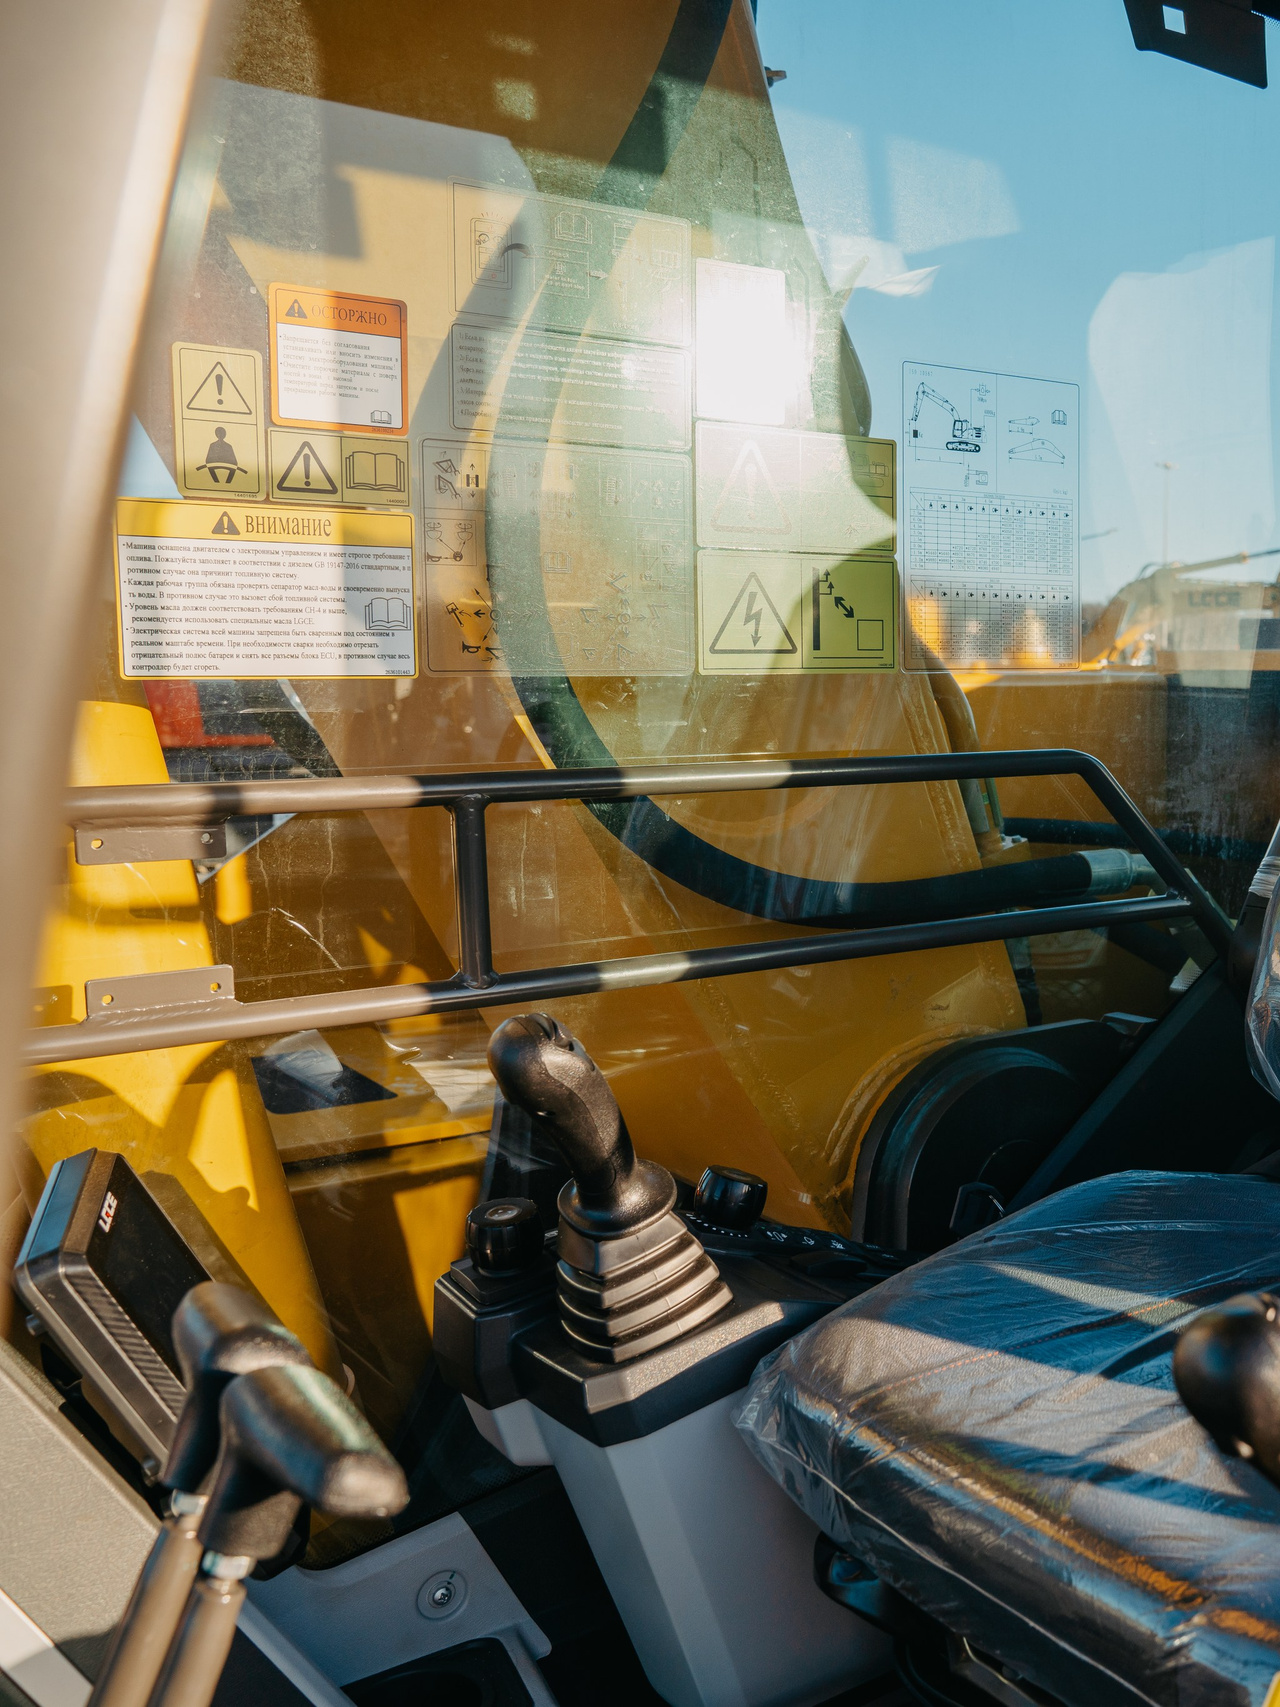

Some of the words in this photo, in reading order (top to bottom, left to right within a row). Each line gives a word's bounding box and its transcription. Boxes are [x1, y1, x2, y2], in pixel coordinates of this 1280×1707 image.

[312, 304, 387, 326] ОСТОРЖНО
[126, 542, 156, 551] Машина
[157, 544, 191, 552] оснащена
[192, 546, 230, 554] двигателем
[237, 548, 280, 556] электронным
[281, 549, 322, 558] управлением
[348, 552, 371, 560] строгое
[372, 552, 406, 561] требование
[154, 554, 197, 564] Пожалуйста
[199, 558, 231, 566] заполняет
[238, 559, 281, 567] соответствии
[314, 560, 325, 569] GB
[327, 561, 360, 570] 19147-2016
[127, 566, 161, 575] ротивном
[162, 568, 186, 576] случае
[201, 569, 233, 578] причинит
[235, 571, 271, 579] топливную
[127, 578, 154, 587] Каждая
[155, 579, 183, 588] рабочая
[184, 581, 208, 589] группа
[209, 580, 236, 589] обязана
[236, 582, 269, 591] проверять
[271, 584, 302, 592] сепаратор
[343, 586, 385, 595] своевременно
[386, 587, 411, 595] выпуска
[138, 592, 157, 600] воды.
[166, 593, 203, 601] противном
[205, 594, 228, 602] случае
[268, 594, 283, 602] сбой
[285, 595, 318, 603] топливной
[129, 602, 159, 611] Уровень
[263, 606, 303, 614] требованиям
[131, 616, 183, 625] рекомендуется
[184, 617, 229, 625] использовать
[230, 618, 272, 626] специальные
[130, 627, 181, 636] Электрическая
[256, 630, 290, 638] запрещена
[292, 629, 307, 637] быть
[130, 640, 164, 648] реальном
[227, 639, 241, 649] При
[242, 640, 291, 648] необходимости
[315, 641, 352, 649] необходимо
[131, 651, 183, 660] отрицательный
[208, 652, 234, 660] батареи
[301, 652, 319, 660] блока
[377, 653, 397, 661] случае
[132, 664, 171, 672] контроллер
[173, 662, 192, 672] будет
